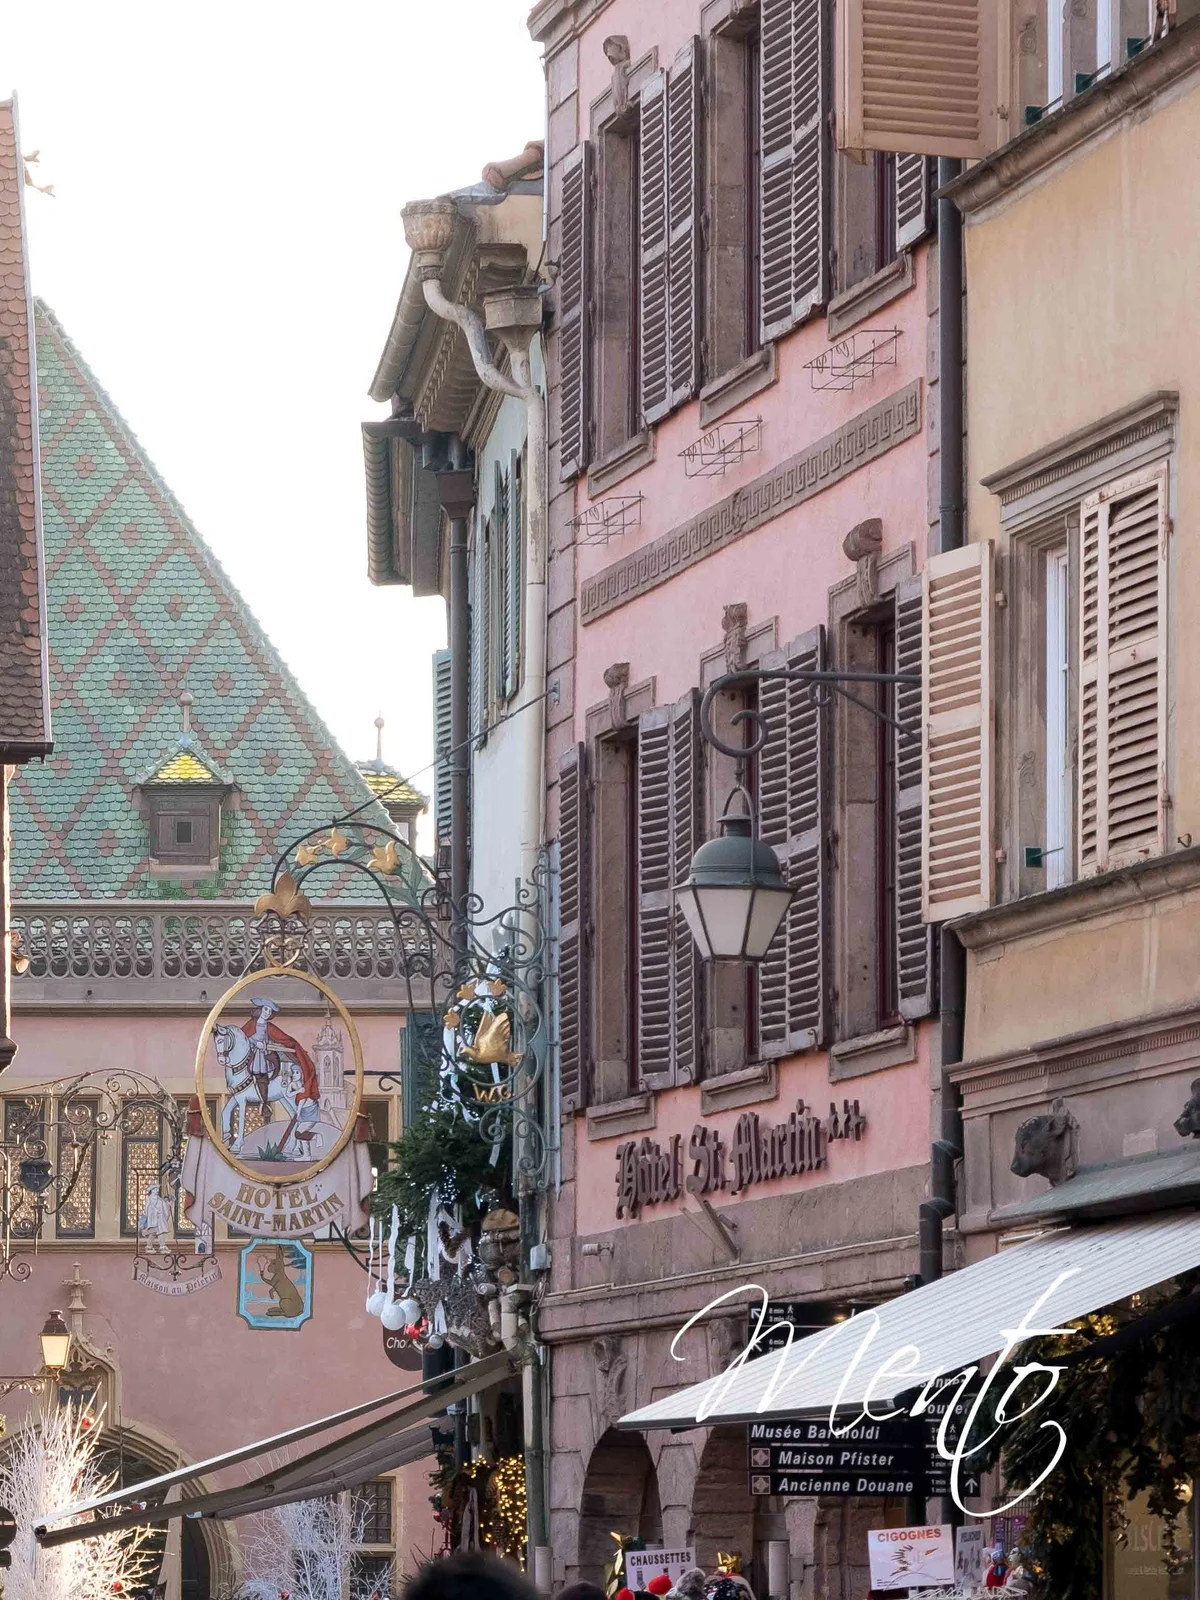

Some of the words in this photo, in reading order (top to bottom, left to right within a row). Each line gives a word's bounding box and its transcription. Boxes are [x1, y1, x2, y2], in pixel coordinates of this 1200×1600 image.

[615, 1133, 683, 1220] Hôtel
[729, 1099, 828, 1195] Martin
[235, 1183, 318, 1209] HOTEL
[207, 1192, 345, 1232] SAINT-MARTIN
[138, 1273, 169, 1293] Maison
[750, 1424, 801, 1439] Musée
[778, 1451, 834, 1466] Maison
[840, 1451, 895, 1466] Pfister
[778, 1478, 851, 1492] Ancienne
[856, 1478, 914, 1493] Douane
[877, 1528, 942, 1543] CIGOGNES
[630, 1551, 692, 1567] CHAUSSETTES
